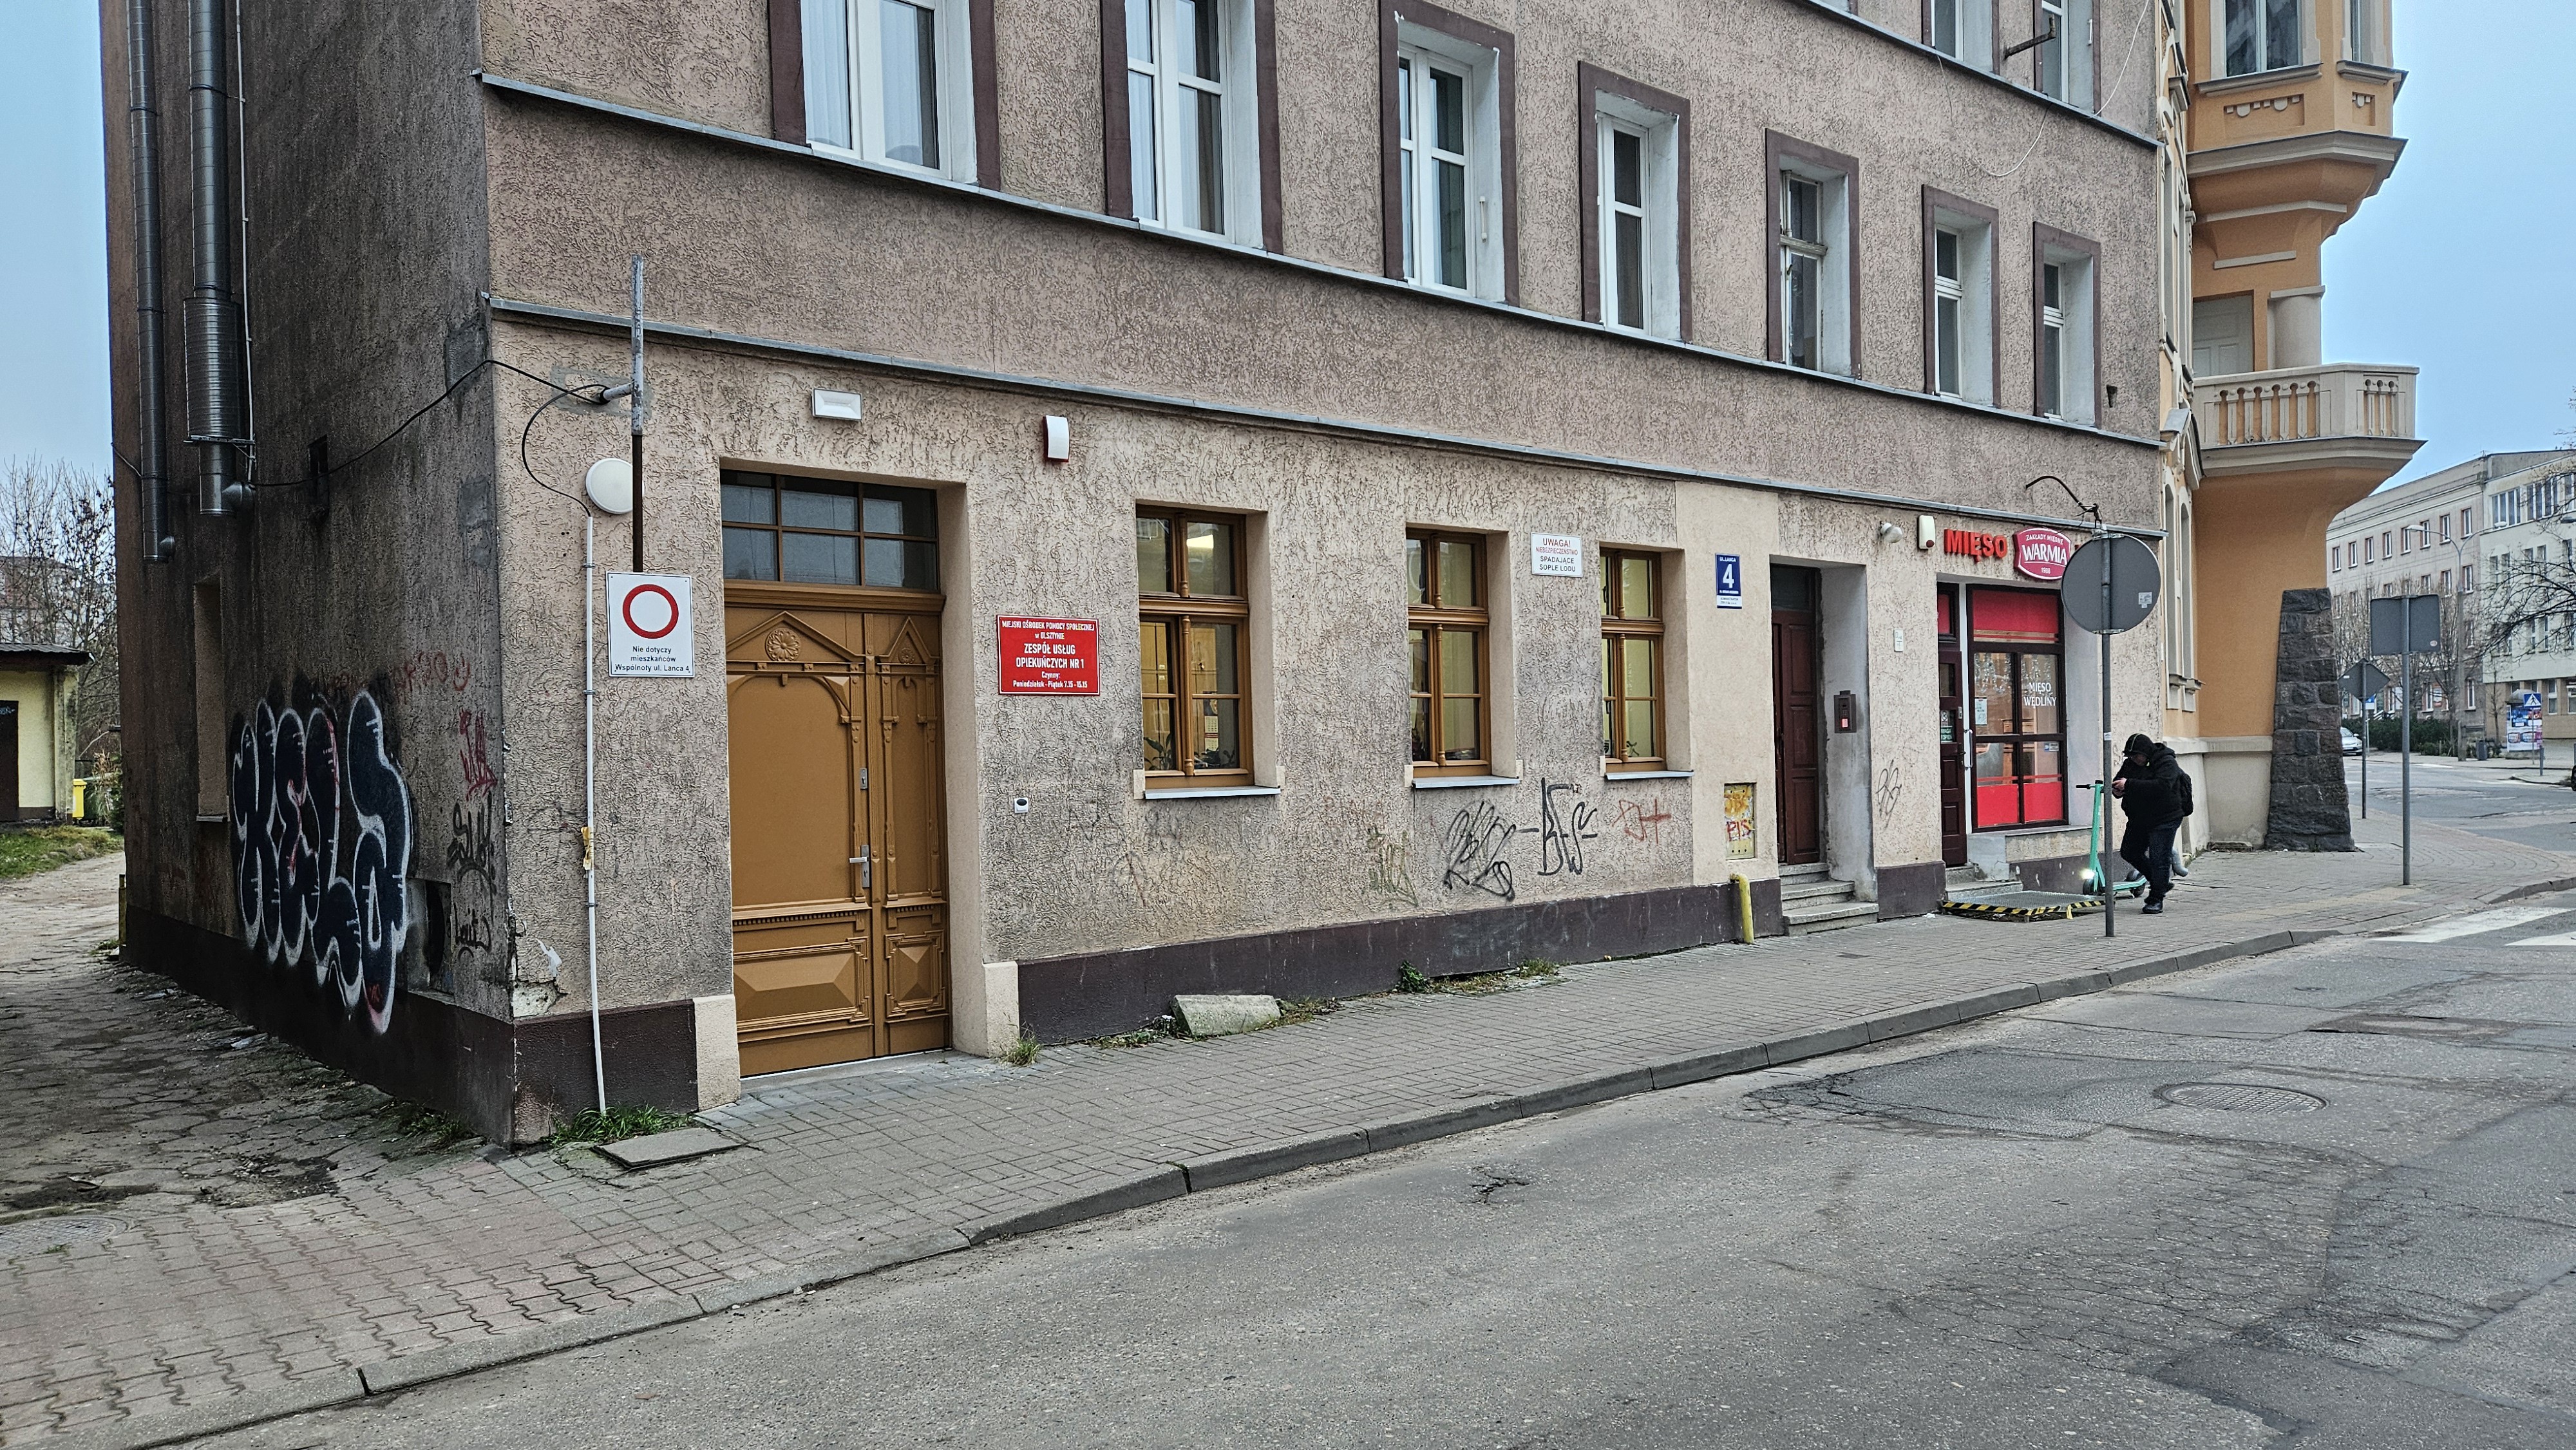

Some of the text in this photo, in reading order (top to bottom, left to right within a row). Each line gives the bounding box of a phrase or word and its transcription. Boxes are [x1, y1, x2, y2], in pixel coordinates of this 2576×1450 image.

[1542, 538, 1571, 547] UWAGA!
[2025, 533, 2047, 541] ZAKŁADY
[1944, 529, 2008, 563] MIĘSO
[1540, 556, 1575, 565] SPADAJĄCE
[2022, 543, 2067, 565] WARMIA
[1723, 563, 1734, 588] 4
[1002, 619, 1095, 632] MIEJSKI OŚRODEK POMOCY SPOŁECZNEJ
[645, 646, 672, 654] dotyczy
[1024, 641, 1076, 655] ZESPÓŁ USŁUG
[615, 663, 652, 672] Wspólnoty
[1016, 655, 1084, 669] OPIEKUŃCZYCH NR 1
[1041, 671, 1061, 680] Czynny:
[1048, 681, 1063, 689] Piątek
[2029, 682, 2052, 695] MIĘSO
[2023, 696, 2057, 709] WĘDLINY
